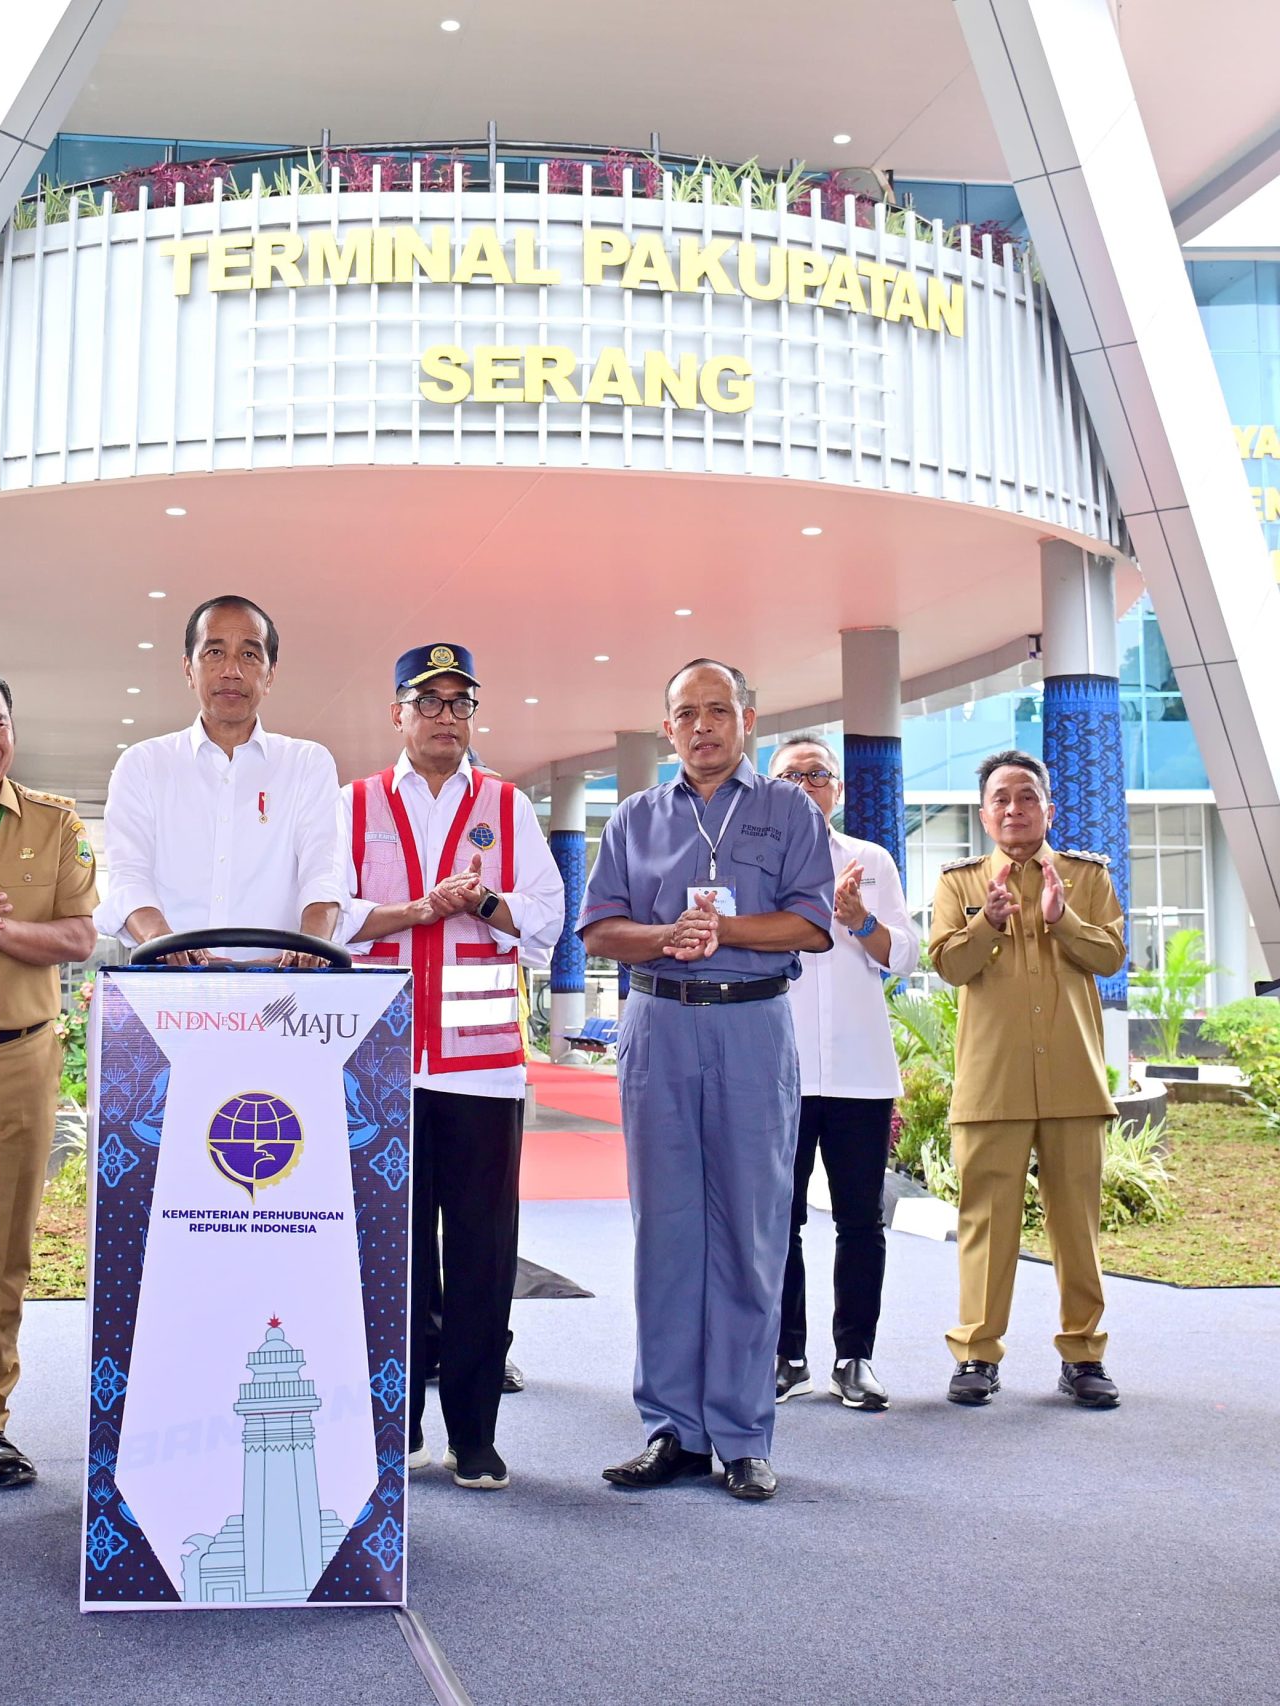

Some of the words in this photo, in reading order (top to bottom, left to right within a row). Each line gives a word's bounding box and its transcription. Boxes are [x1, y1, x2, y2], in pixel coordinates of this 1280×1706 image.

[160, 226, 561, 296] TERMINAL
[582, 228, 964, 338] PAKUPATAN
[418, 344, 756, 414] SERANG
[155, 1011, 267, 1032] INDONESIA
[280, 1013, 360, 1044] MAJU
[162, 1210, 249, 1219] KEMENTERIAN
[253, 1210, 344, 1220] PERHUBUNGAN
[189, 1223, 247, 1233] REPUBLIK
[250, 1224, 317, 1234] INDONESIA
